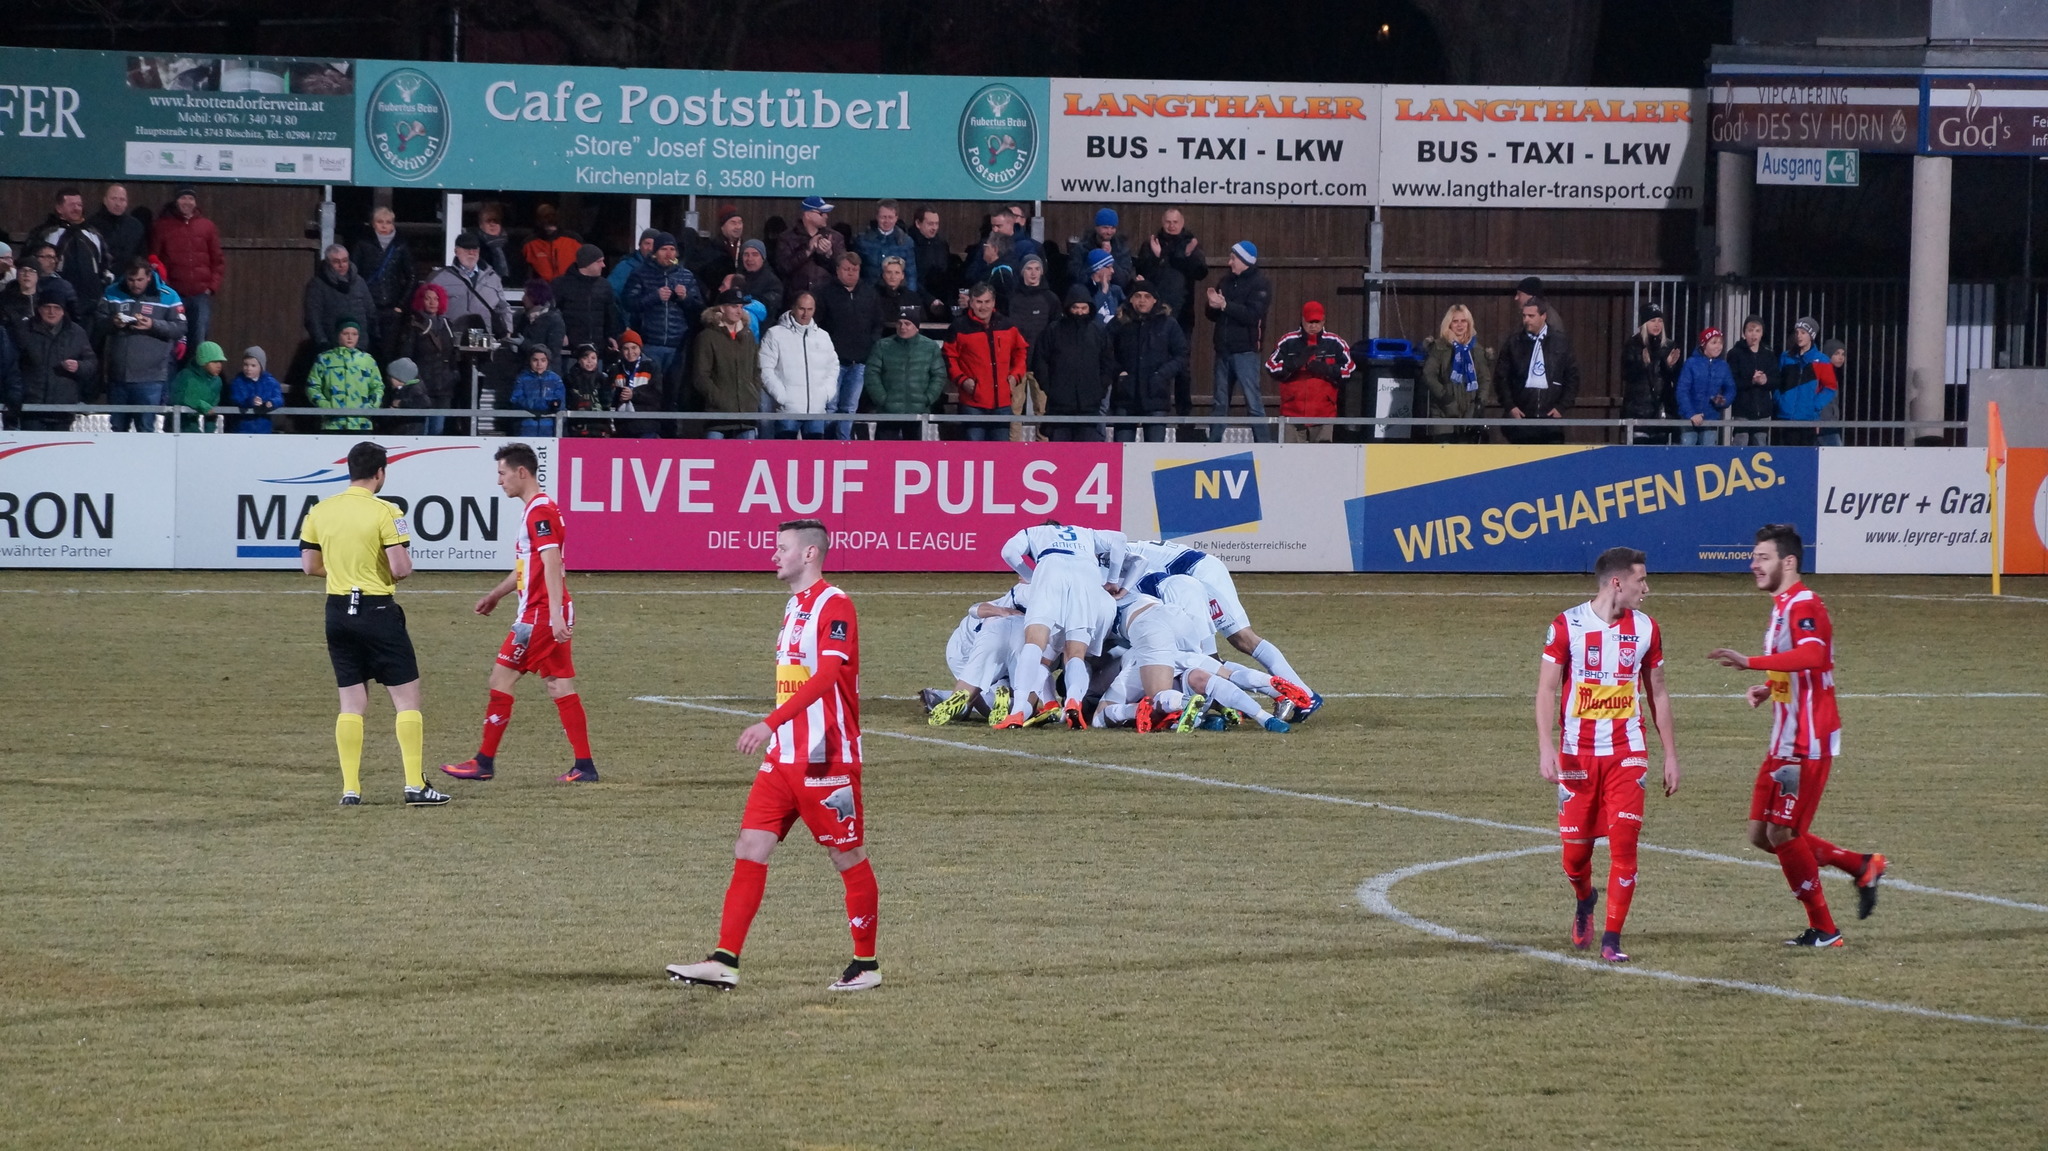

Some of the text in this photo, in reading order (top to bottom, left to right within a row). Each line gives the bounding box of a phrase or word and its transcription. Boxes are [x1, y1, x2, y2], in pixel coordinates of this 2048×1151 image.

[149, 94, 325, 112] www.krottendorferwein.at
[484, 81, 912, 130] Cafe Poststüberl
[1063, 93, 1367, 121] LANGTHALER
[1395, 98, 1693, 123] LANGTHALER
[178, 112, 211, 123] Mobil:
[214, 113, 239, 124] 0676
[248, 114, 267, 125] 340
[270, 115, 282, 125] 74
[284, 115, 298, 125] 80
[1757, 112, 1791, 140] DES
[1800, 112, 1823, 140] SV
[1831, 113, 1883, 141] HORN
[1938, 112, 2011, 147] God's
[317, 131, 337, 141] 2727
[1086, 135, 1148, 158] BUS
[1177, 136, 1246, 160] TAXI
[1276, 139, 1344, 162] LKW
[376, 132, 440, 170] Poststüberl
[647, 136, 706, 158] Josef
[712, 138, 820, 164] Steininger
[1417, 140, 1478, 163] BUS
[1506, 141, 1574, 164] TAXI
[1604, 142, 1671, 165] LKW
[968, 146, 1028, 183] Poststüberl
[1762, 152, 1822, 182] Ausgang
[576, 166, 815, 190] Kirchenplatz 6, 3580 Horn
[1061, 175, 1367, 199] www.langthaler-transport.com
[1392, 179, 1694, 203] www.langthaler-transport.com
[570, 457, 1113, 514] LIVE AUF PULS 4
[1194, 470, 1249, 499] NV
[1393, 452, 1786, 563] WIR SCHAFFEN DAS.
[1824, 486, 1910, 520] Leyrer
[1915, 496, 1931, 514] +
[0, 544, 113, 558] währter Partner
[407, 546, 498, 559] hrter Partner
[708, 531, 740, 549] DIE
[748, 531, 779, 549] UE
[897, 532, 977, 550] LEAGUE
[1194, 540, 1307, 550] Die Niederösterreichische
[1699, 551, 1754, 560] www.noev
[1584, 670, 1609, 679] BHDT
